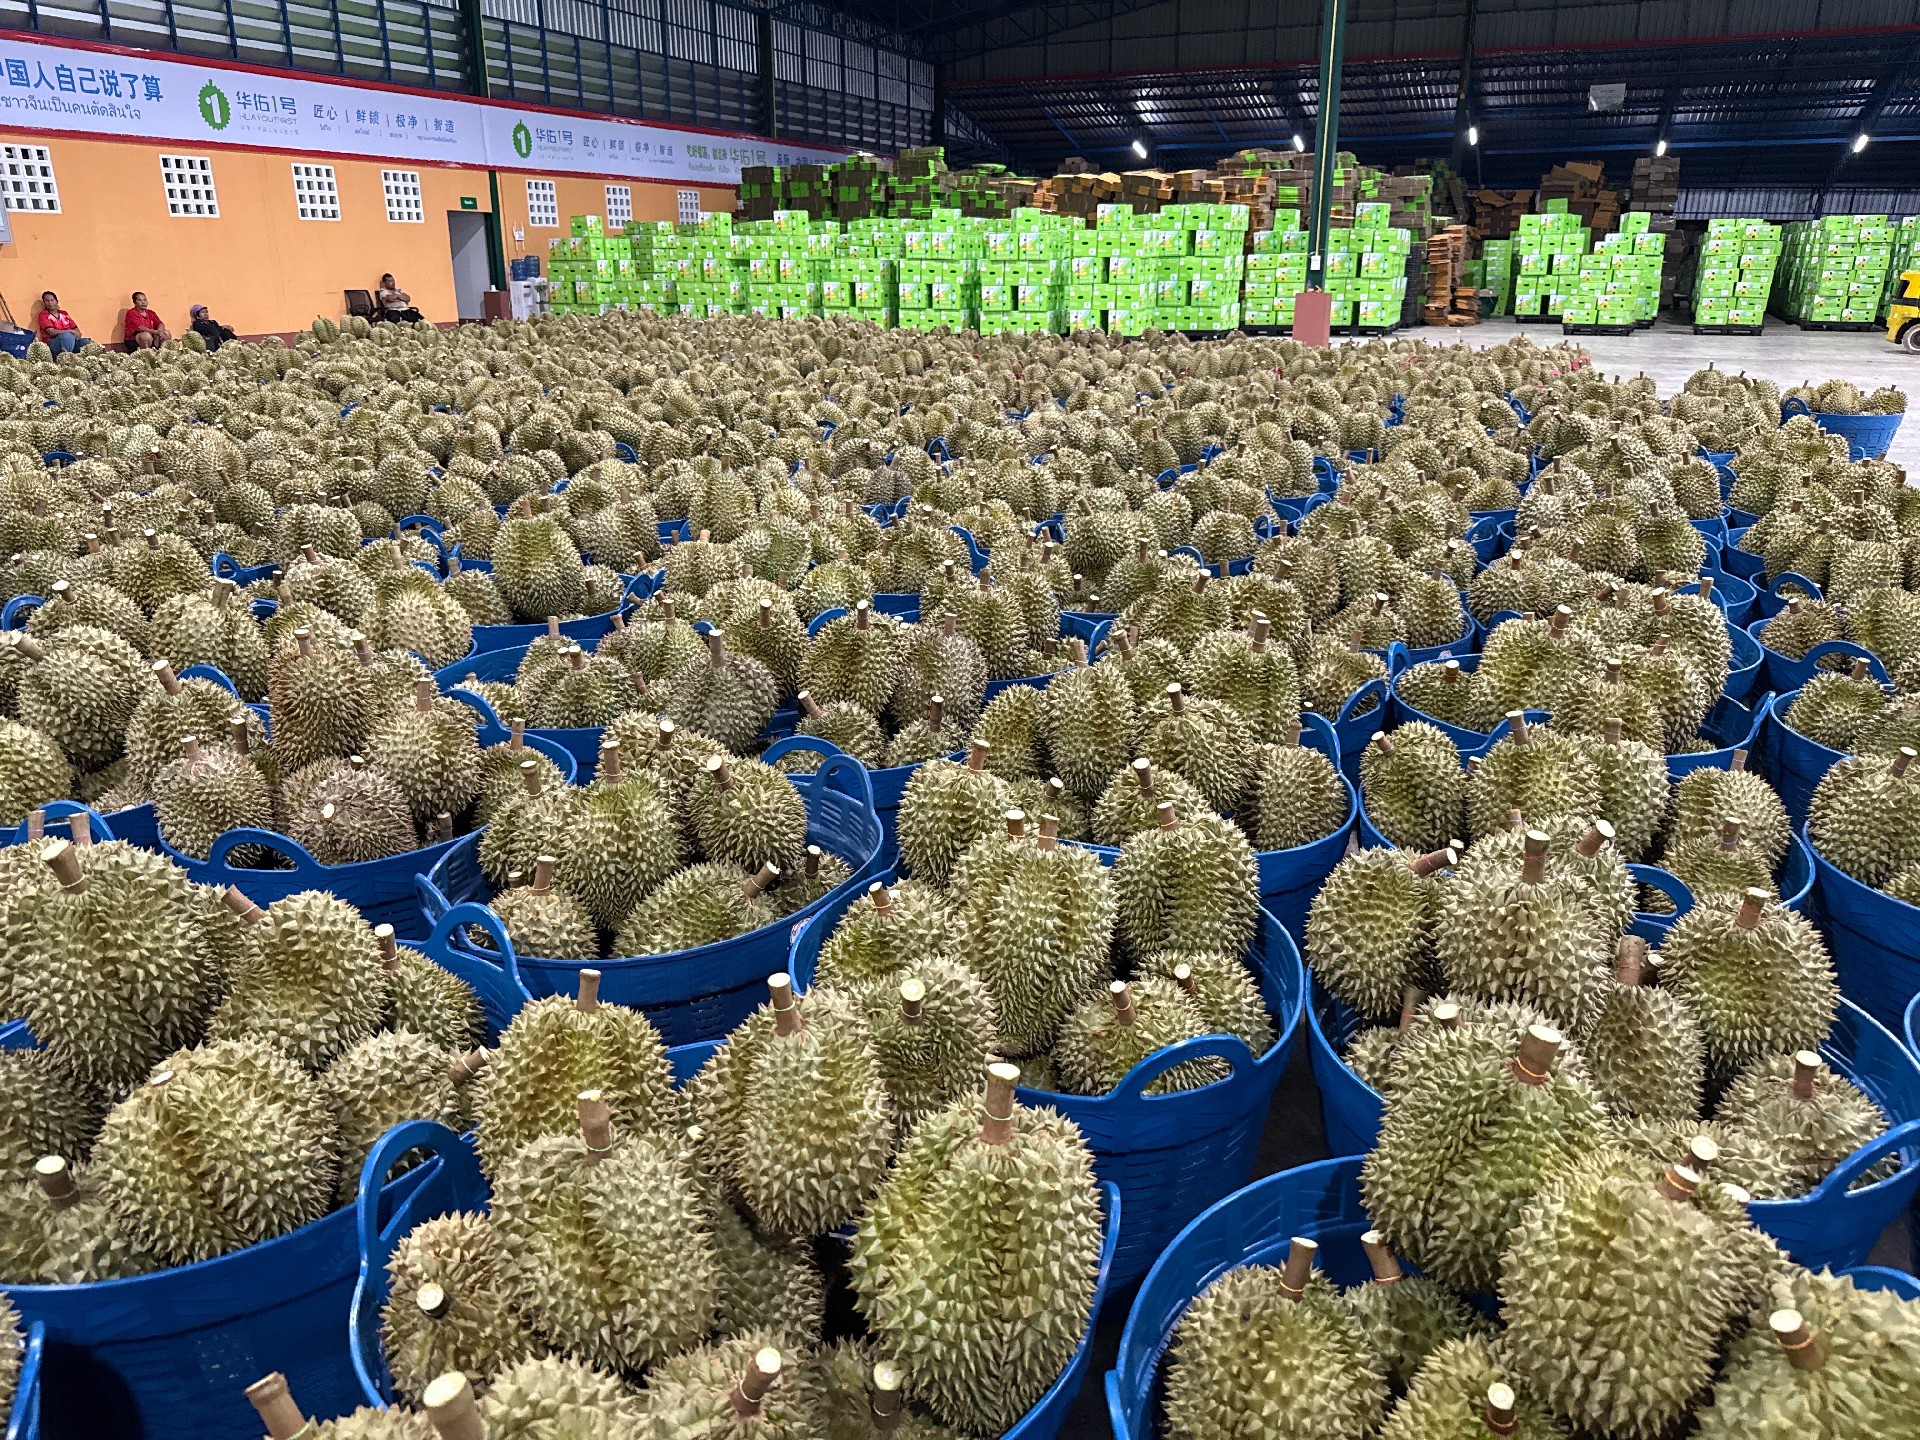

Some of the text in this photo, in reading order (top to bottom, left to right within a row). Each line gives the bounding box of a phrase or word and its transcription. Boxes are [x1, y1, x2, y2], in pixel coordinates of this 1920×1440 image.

[0, 58, 164, 102] 国人自己说了算
[0, 94, 141, 120] ชาวจีนเป็นคนตัดสินใจ
[313, 104, 338, 121] 匠心
